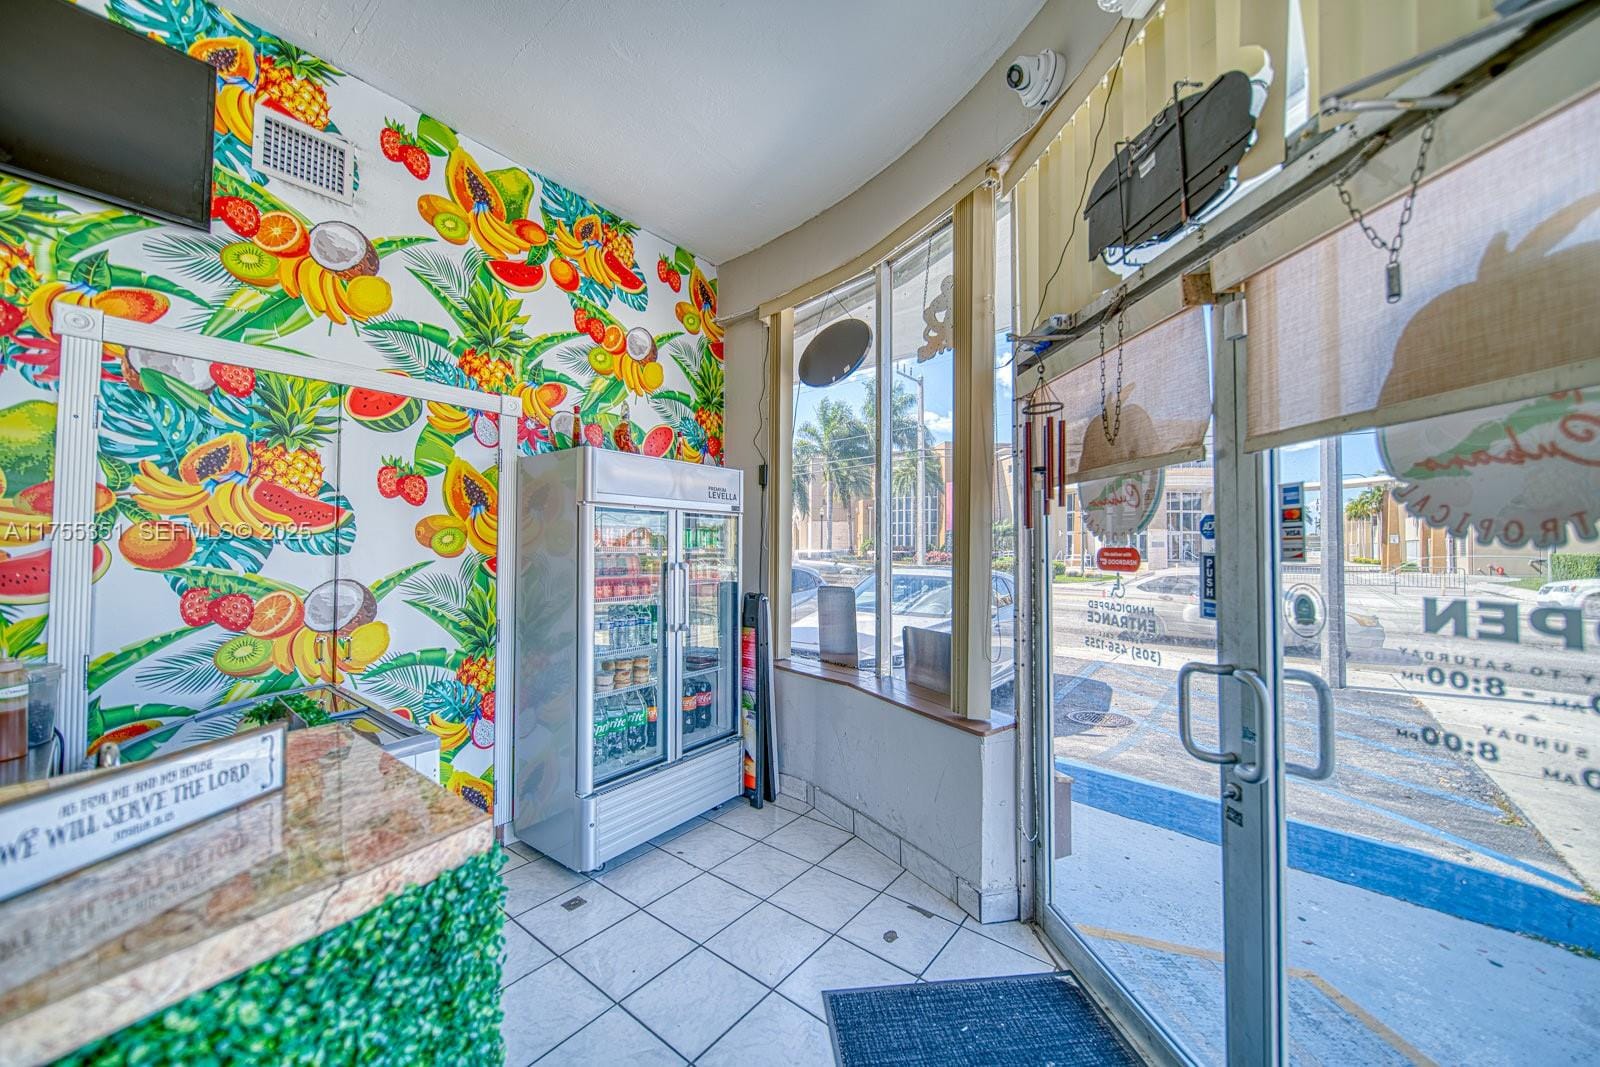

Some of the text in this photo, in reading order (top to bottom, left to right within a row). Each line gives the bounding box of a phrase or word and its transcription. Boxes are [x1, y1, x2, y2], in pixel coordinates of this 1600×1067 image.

[708, 491, 738, 501] LEVELLA
[1284, 529, 1301, 537] VISA
[1206, 558, 1214, 598] PUSH
[46, 811, 99, 849] WILL
[103, 791, 168, 829] SERVE
[173, 777, 207, 805] THE
[208, 762, 250, 791] LORD
